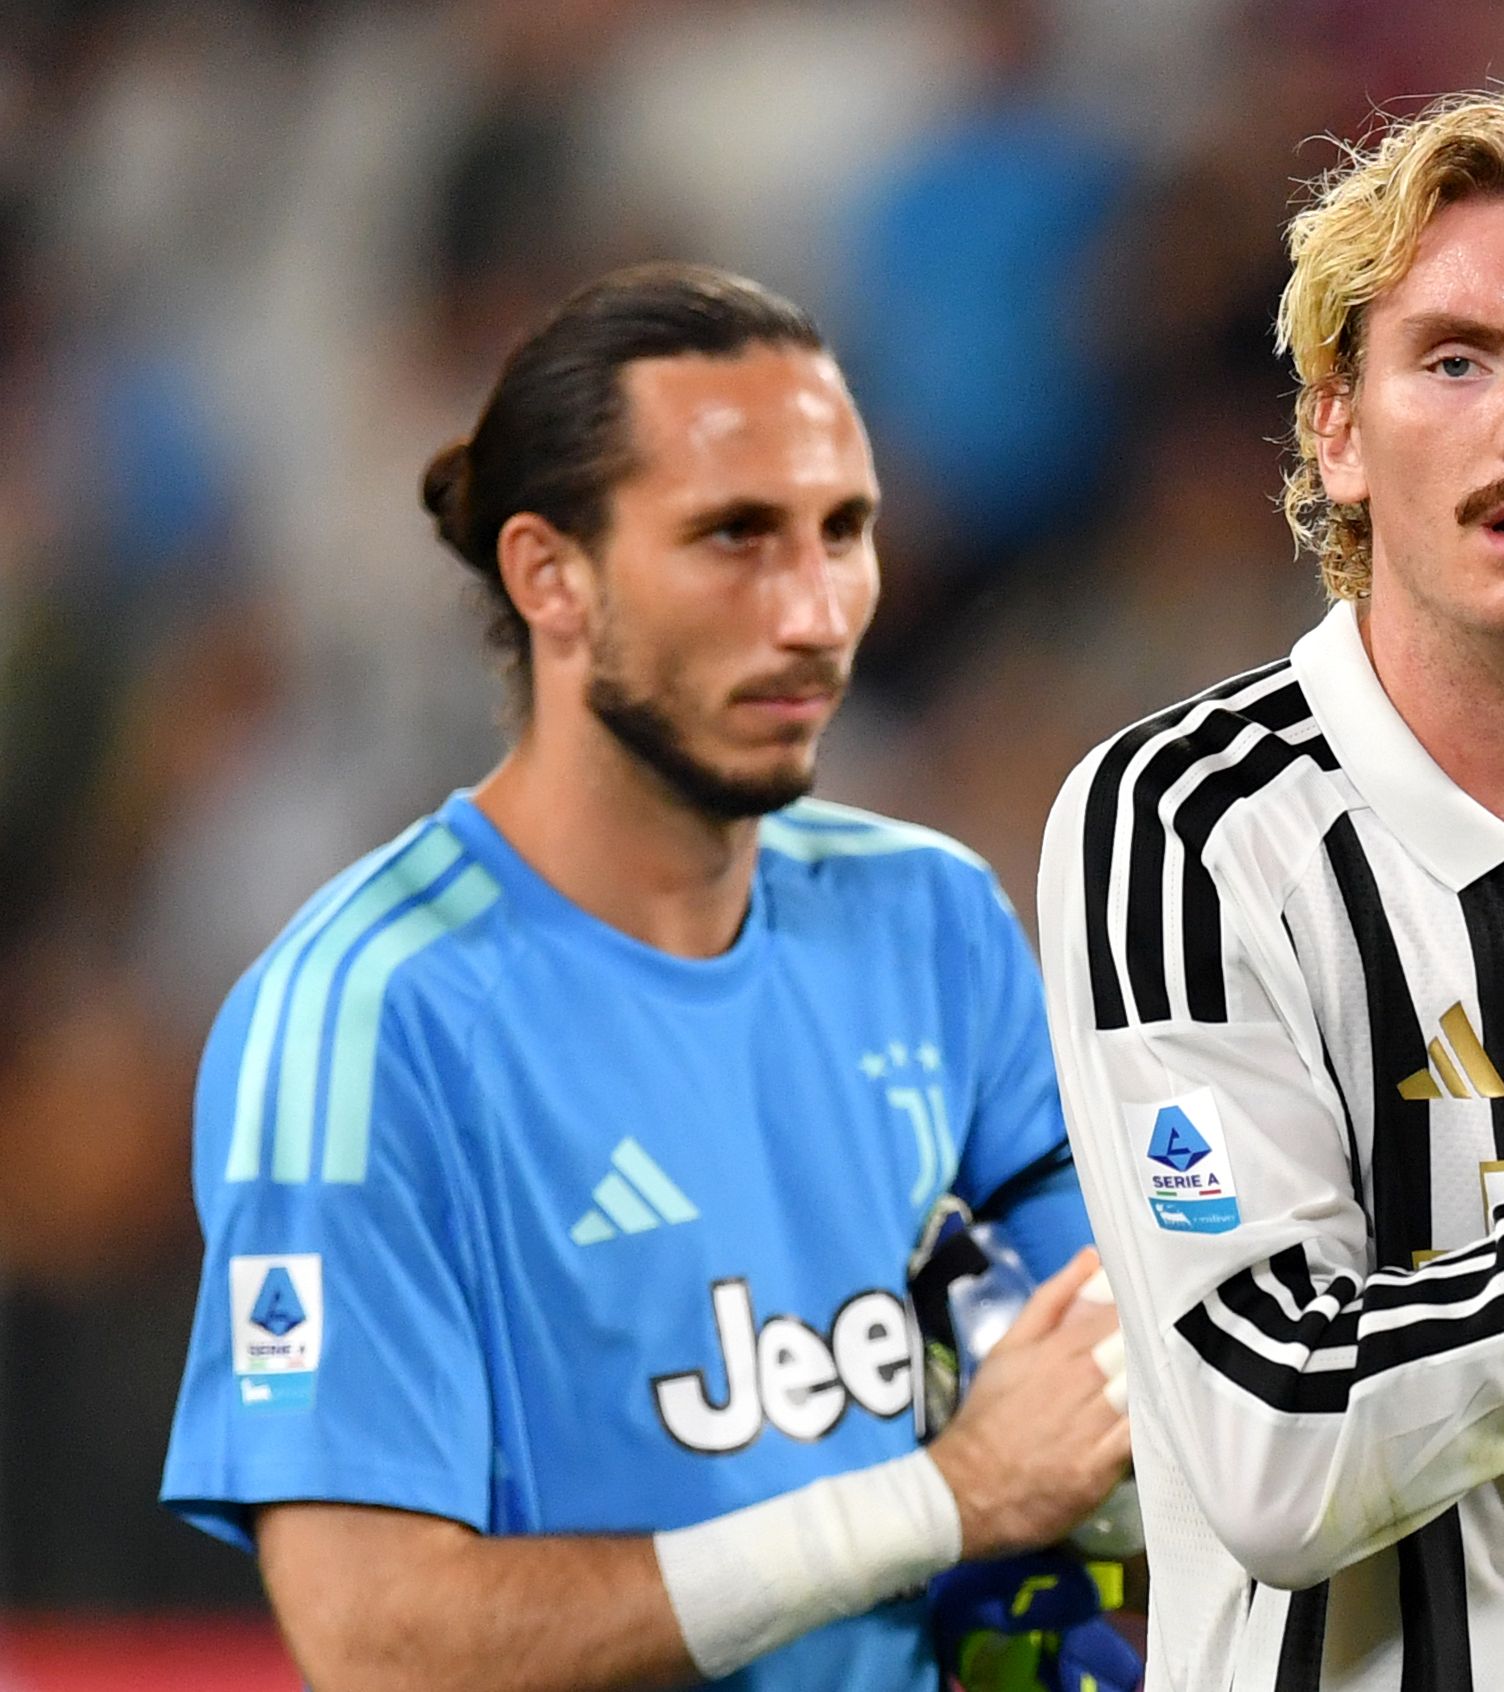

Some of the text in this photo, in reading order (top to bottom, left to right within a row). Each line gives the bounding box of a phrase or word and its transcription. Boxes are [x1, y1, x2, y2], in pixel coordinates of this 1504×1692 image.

[1152, 1172, 1220, 1188] SERIE A
[650, 1276, 912, 1457] Jee
